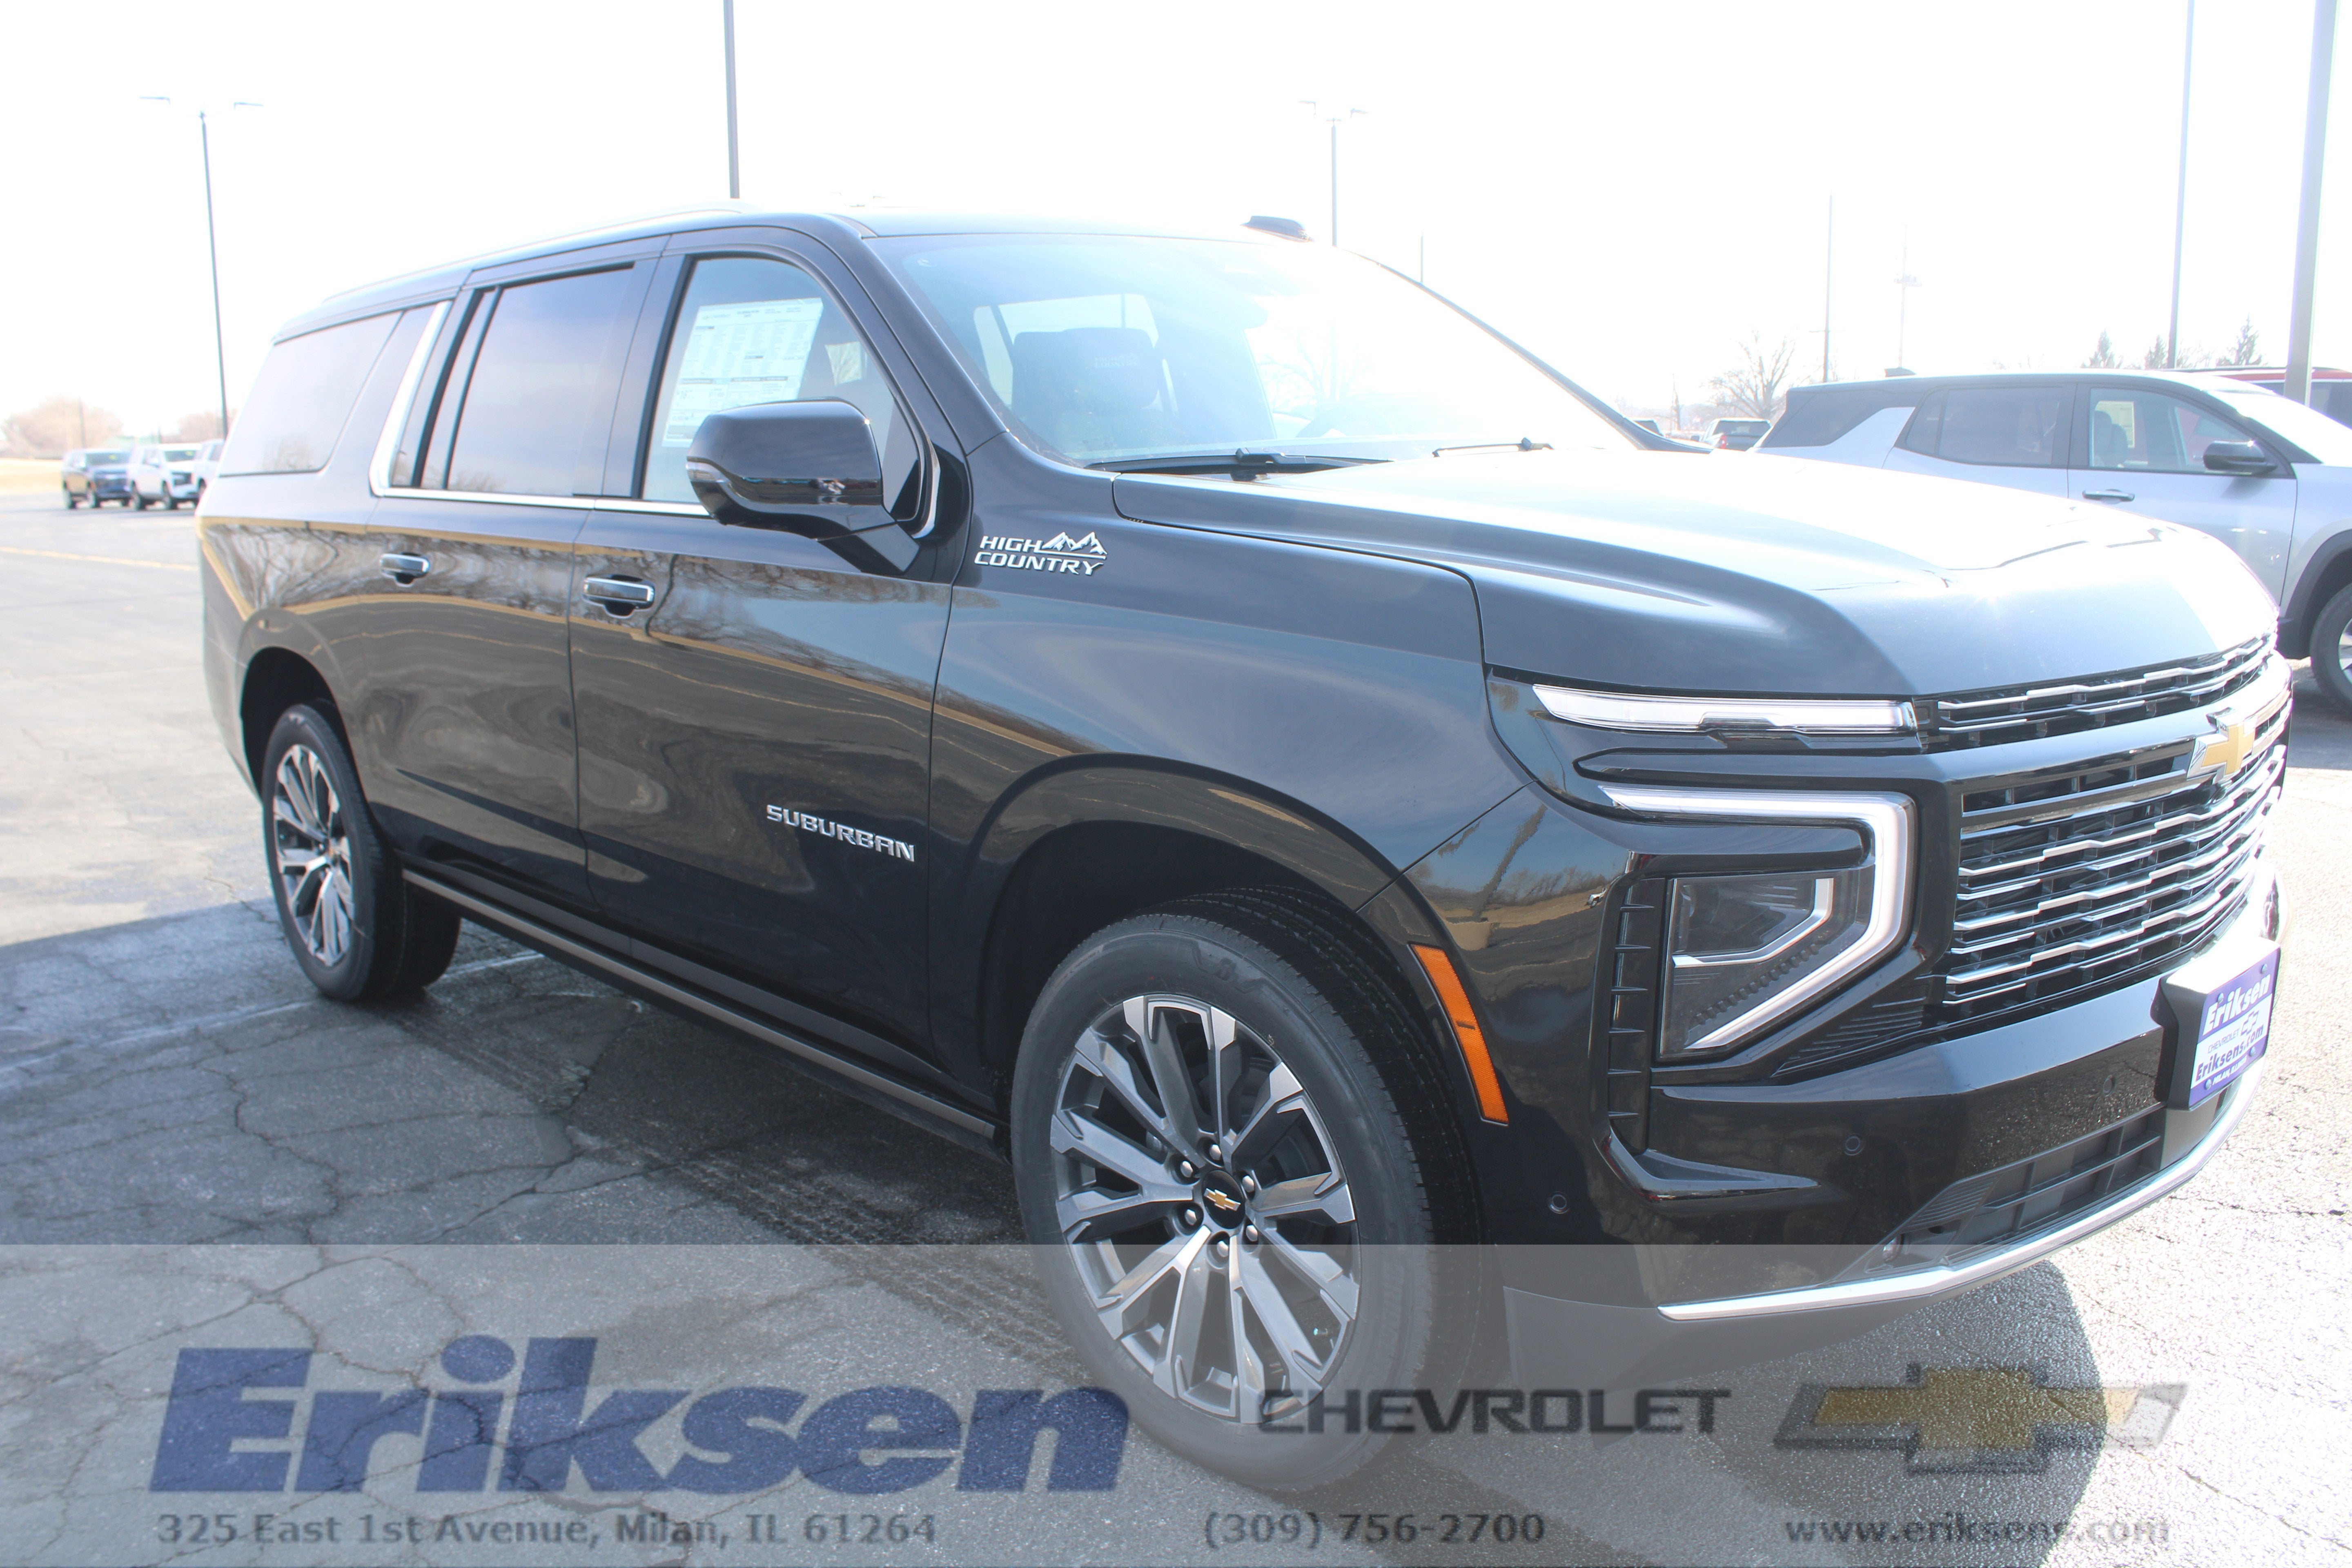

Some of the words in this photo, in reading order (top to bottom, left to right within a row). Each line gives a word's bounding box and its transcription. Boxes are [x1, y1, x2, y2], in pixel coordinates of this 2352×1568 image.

[974, 551, 1104, 576] COUNTRY
[980, 535, 1042, 553] HIGH
[766, 804, 915, 862] SUBURBAN
[2203, 974, 2271, 1036] Eriksen
[2196, 1024, 2263, 1081] Eriksens.com
[2207, 1029, 2240, 1054] CHEVROLET
